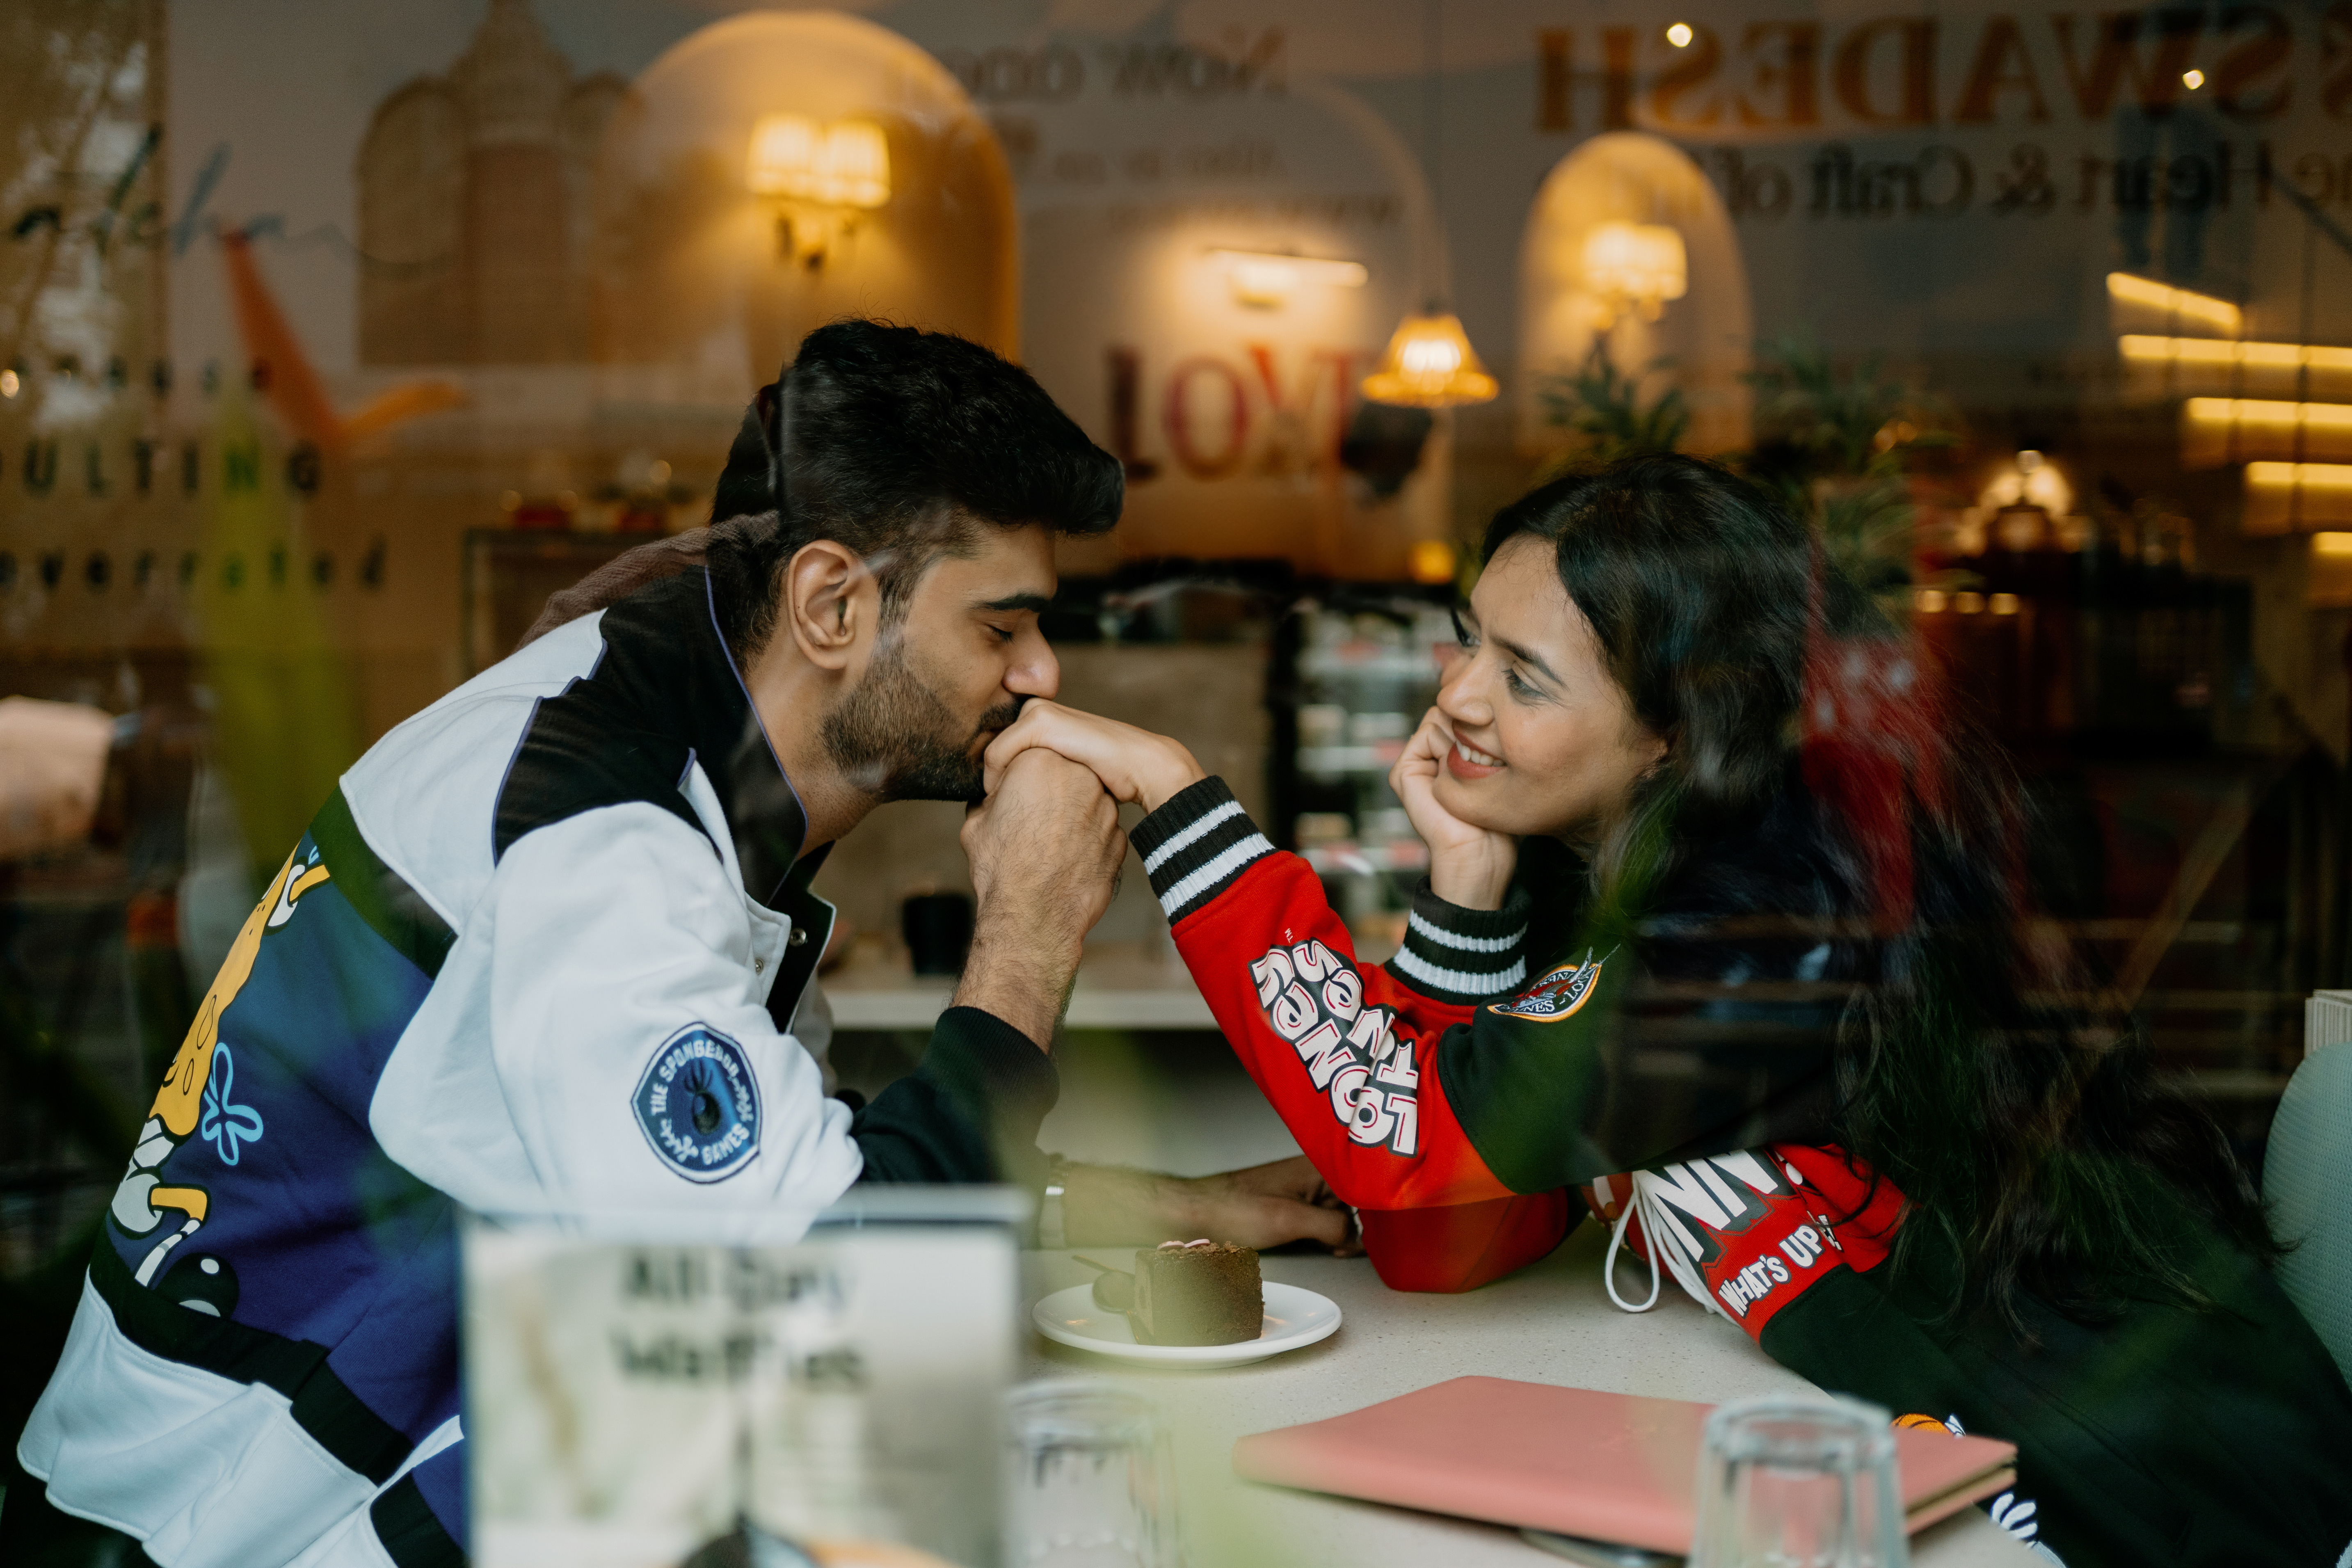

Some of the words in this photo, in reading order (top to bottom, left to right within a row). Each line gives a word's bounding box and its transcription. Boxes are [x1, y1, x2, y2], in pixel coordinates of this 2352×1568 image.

[0, 434, 323, 501] ULTING
[650, 1082, 669, 1116] THE
[1718, 1254, 1789, 1317] WHAT'S
[1778, 1225, 1823, 1268] UP
